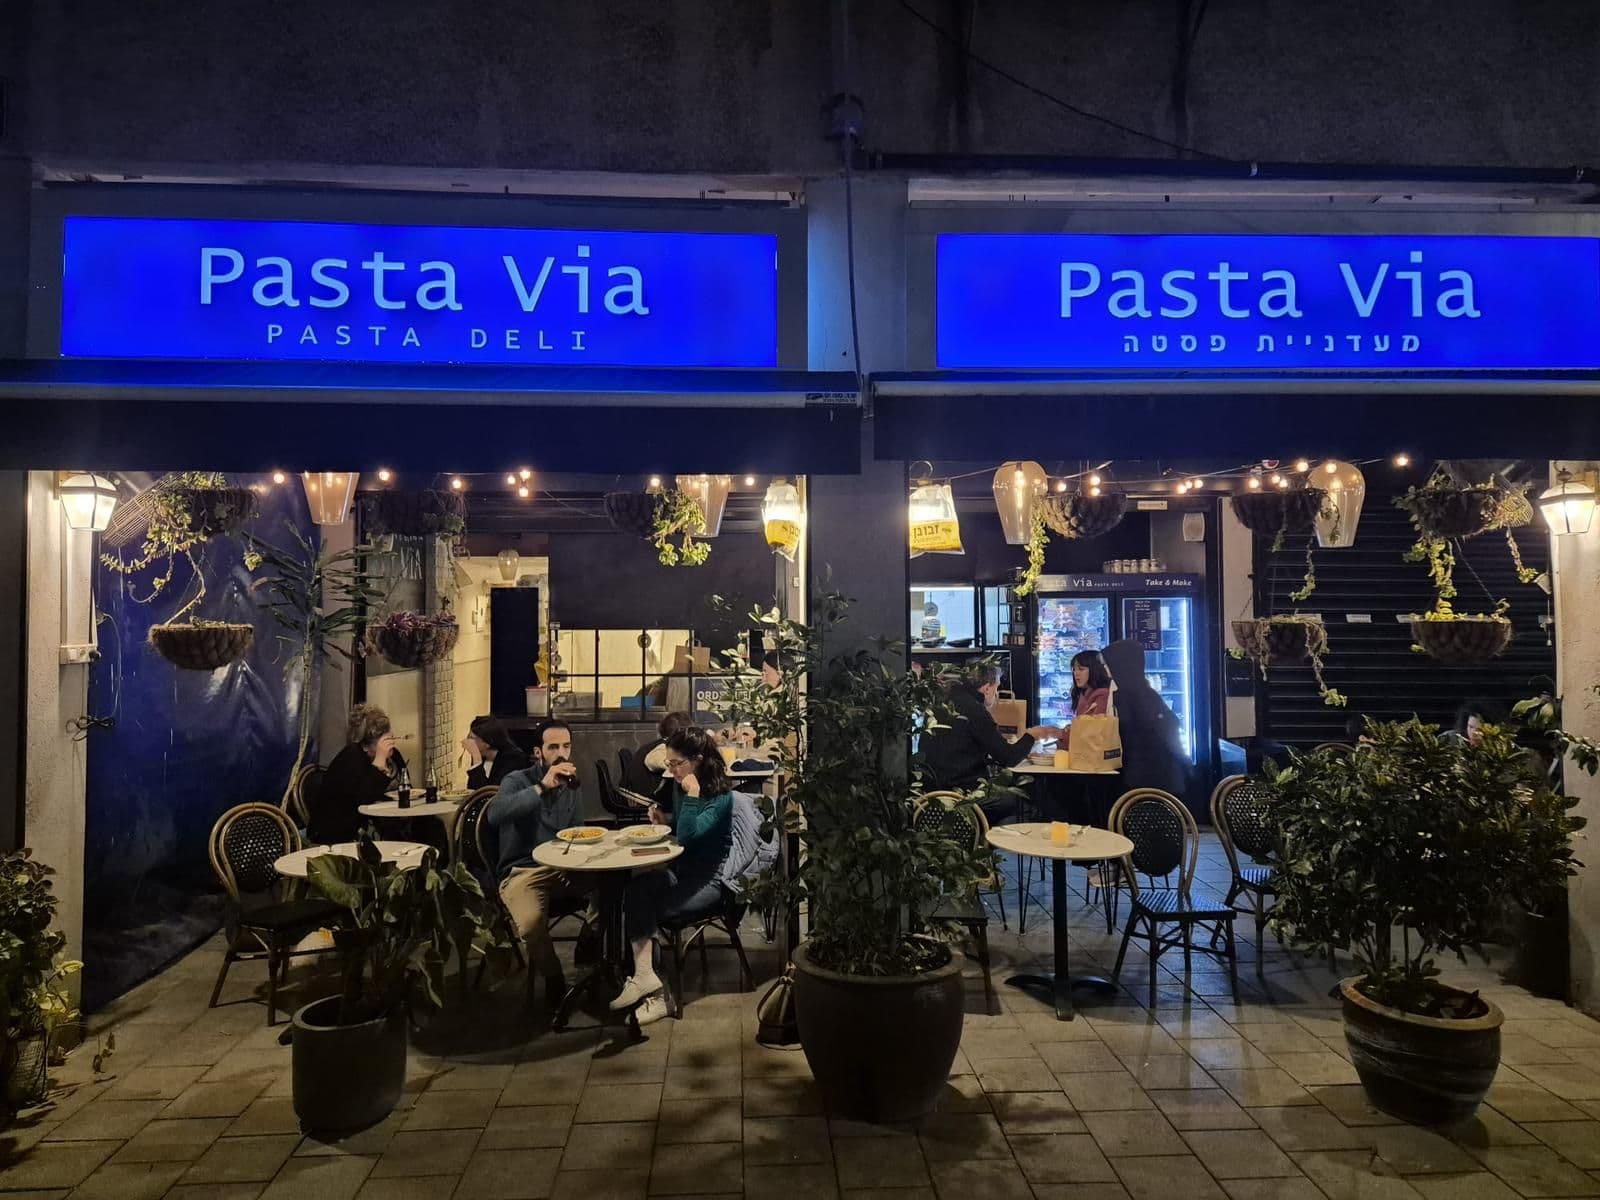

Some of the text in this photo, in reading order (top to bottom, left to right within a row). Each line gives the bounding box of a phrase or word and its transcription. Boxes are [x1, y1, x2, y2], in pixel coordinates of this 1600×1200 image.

[200, 244, 650, 315] Pasta Via
[1060, 250, 1482, 319] Pasta Via
[267, 323, 587, 351] PASTA DELI
[1123, 334, 1420, 353] מעדניית פסטה
[1145, 578, 1163, 587] Take
[1172, 578, 1192, 587] Make
